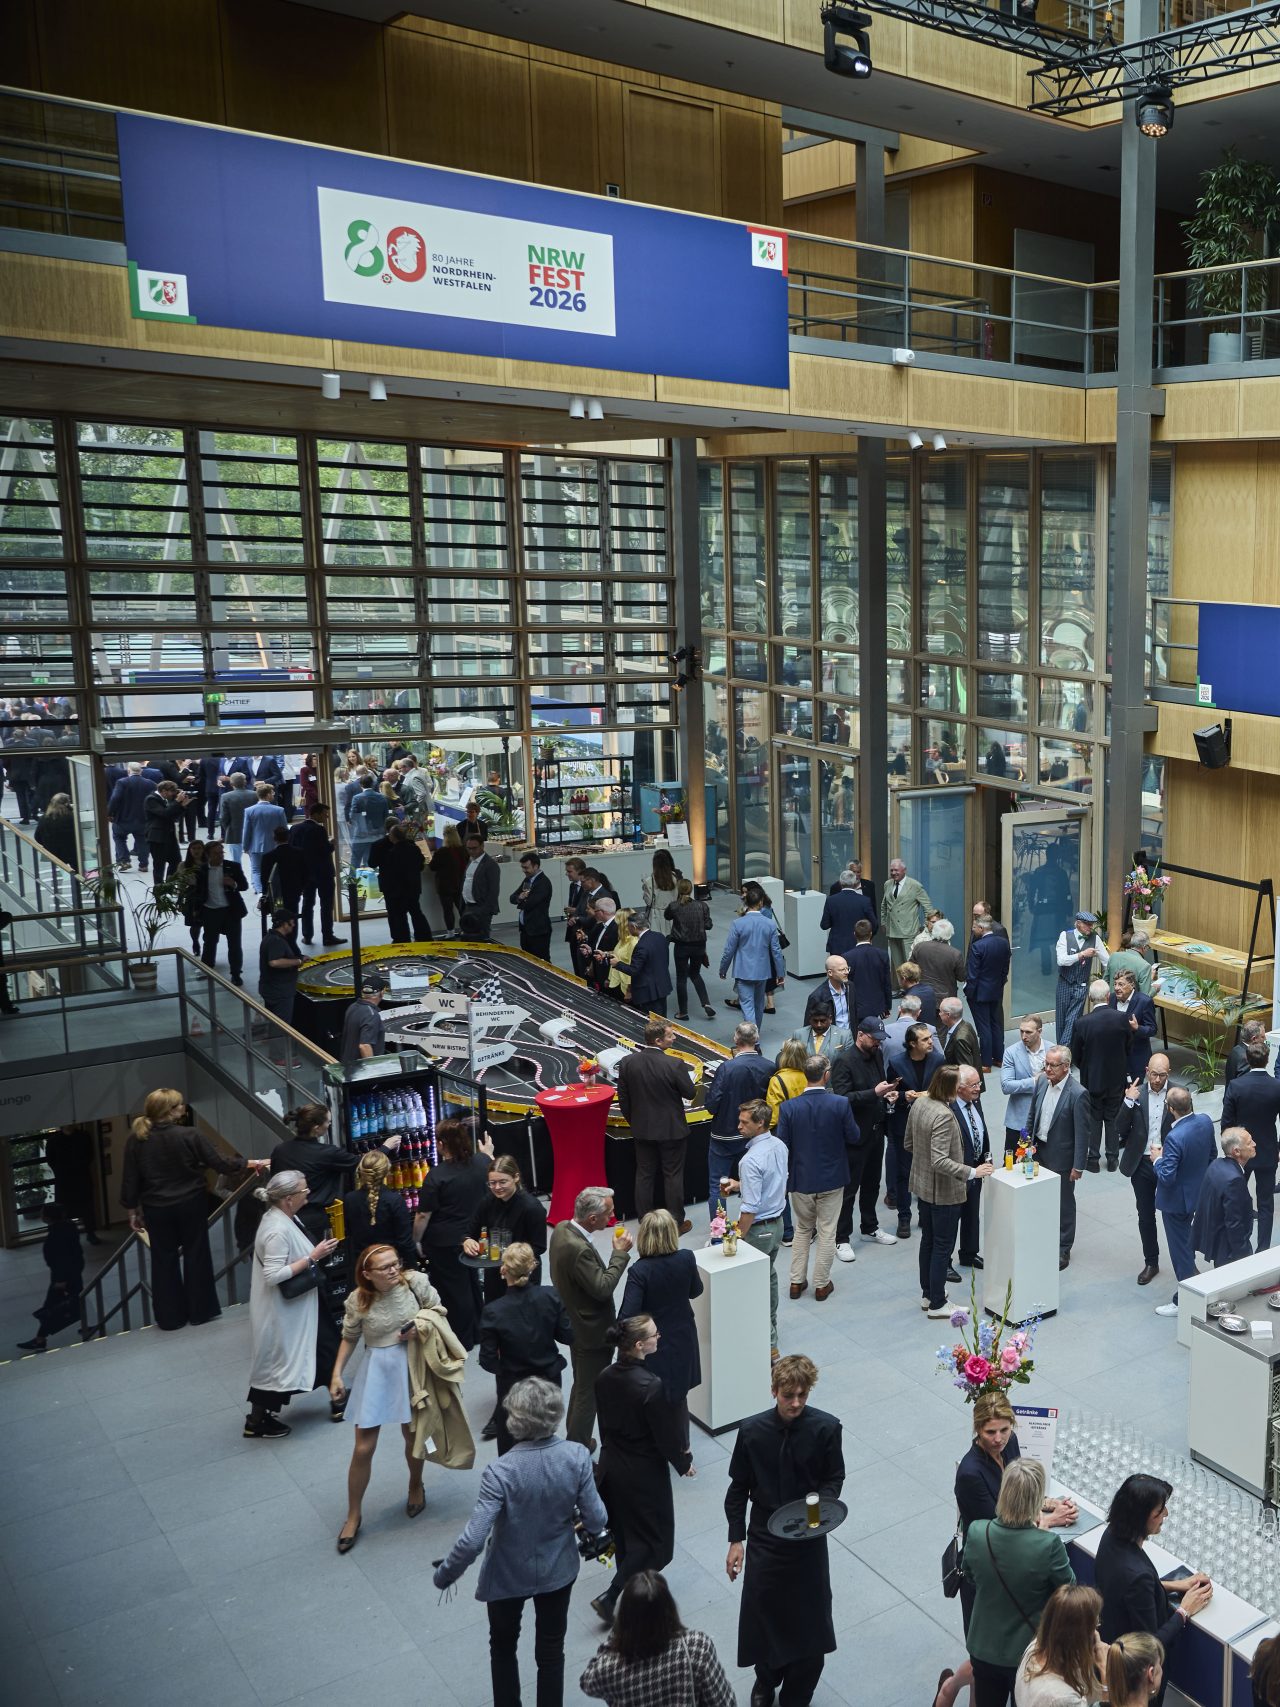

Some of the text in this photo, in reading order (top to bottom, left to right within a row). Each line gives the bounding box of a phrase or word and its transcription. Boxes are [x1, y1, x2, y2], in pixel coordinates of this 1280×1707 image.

[431, 253, 475, 267] 80 JAHRE
[527, 244, 585, 270] NRW
[432, 265, 497, 282] NORDRHEIN-
[528, 264, 585, 291] FEST
[433, 276, 492, 292] WESTFALEN
[529, 286, 587, 313] 2026
[438, 998, 455, 1008] WC
[475, 1009, 515, 1017] BEHINDERTEN
[477, 1050, 505, 1062] GETRÄNKE
[1015, 1408, 1039, 1416] Getränke
